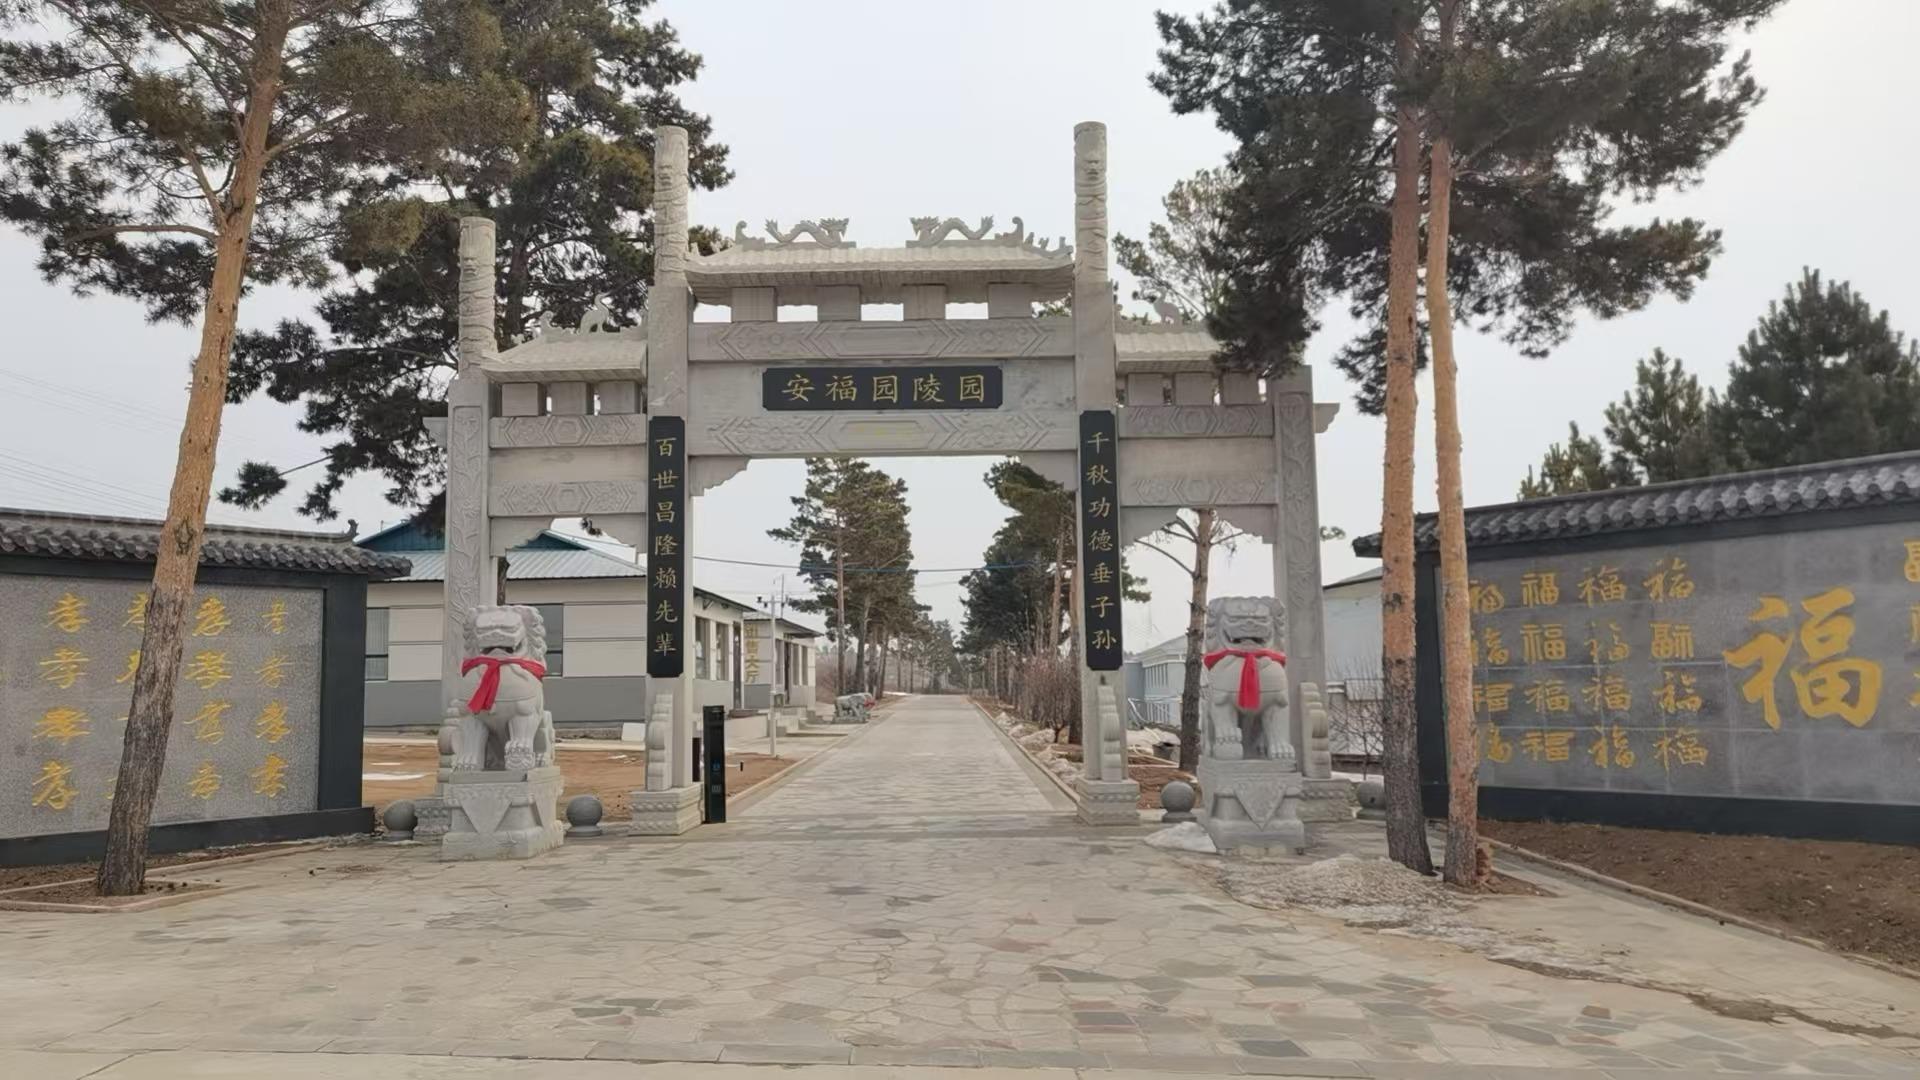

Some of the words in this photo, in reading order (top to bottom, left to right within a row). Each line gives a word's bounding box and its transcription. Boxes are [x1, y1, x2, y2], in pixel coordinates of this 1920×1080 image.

[782, 374, 985, 403] 安福园陵园
[653, 437, 678, 656] 百世昌隆赖先辈
[1086, 432, 1117, 650] 千秋功德垂子孙
[1520, 572, 1560, 608] 福
[1577, 566, 1627, 608] 福
[1520, 623, 1567, 664] 福
[1724, 586, 1883, 731] 福
[1525, 679, 1571, 712] 福
[1581, 675, 1632, 711] 福
